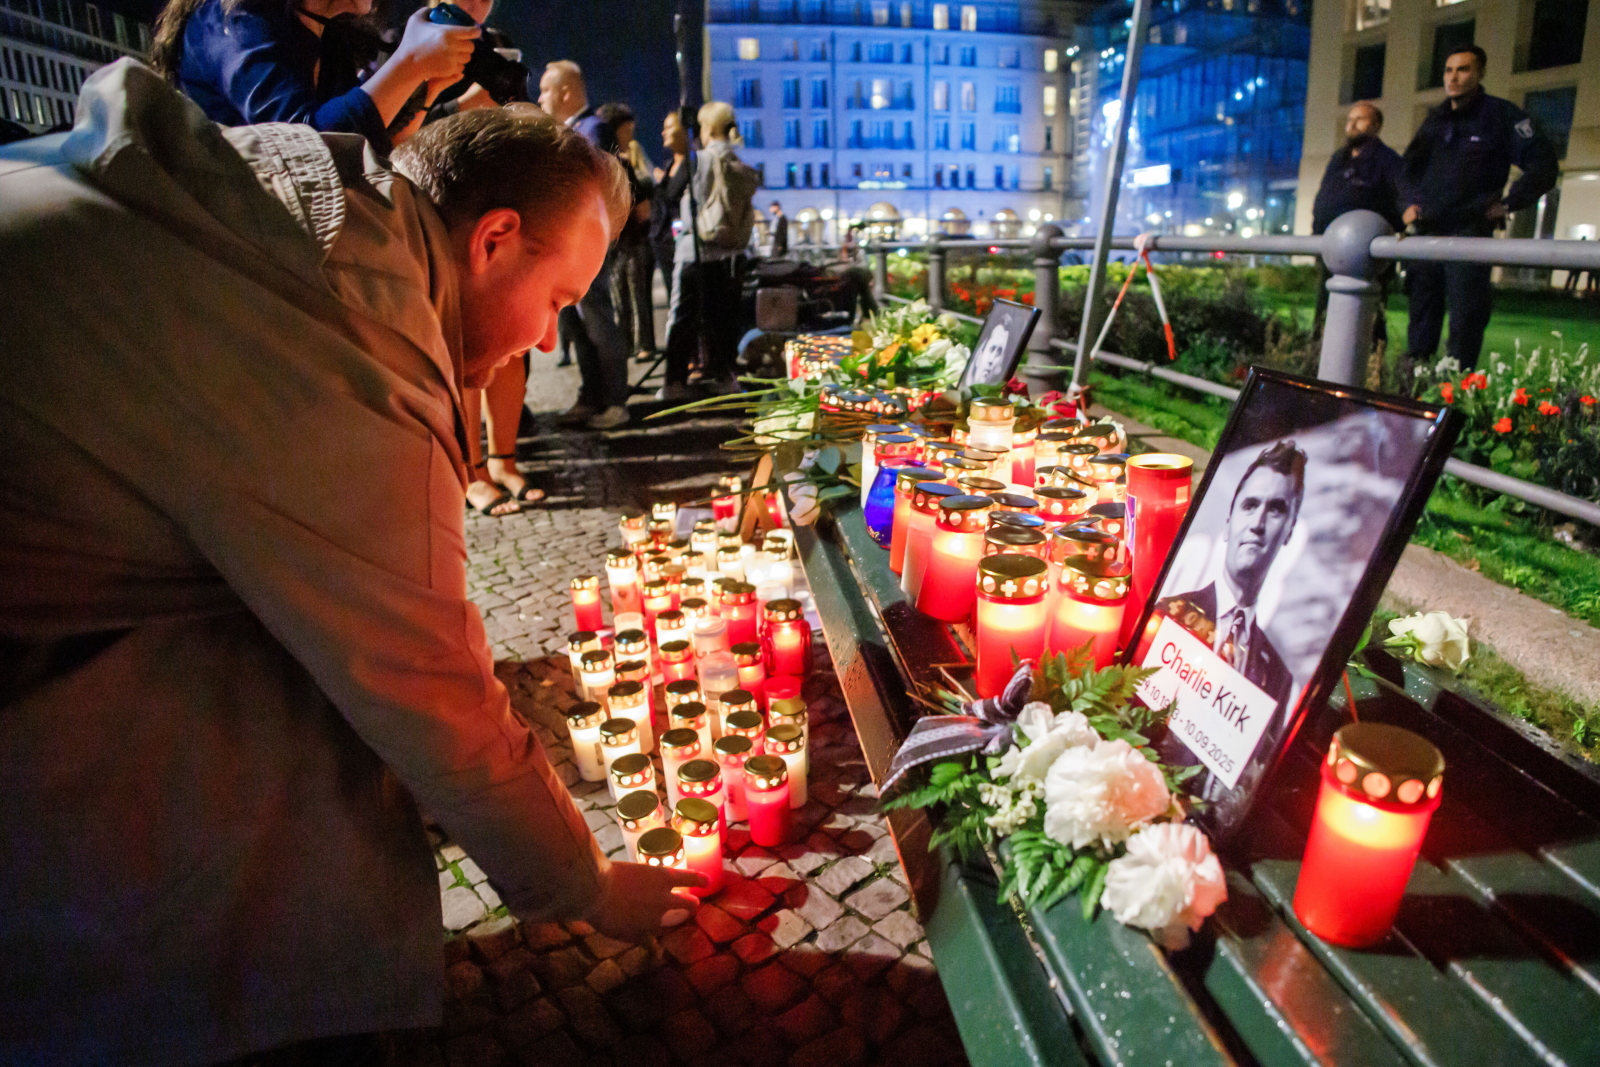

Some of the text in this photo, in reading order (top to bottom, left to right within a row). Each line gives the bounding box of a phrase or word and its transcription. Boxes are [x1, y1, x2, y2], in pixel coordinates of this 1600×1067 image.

[1141, 679, 1180, 720] 4.10.193
[1184, 719, 1235, 773] 10.09.2025
[1161, 642, 1252, 733] Charlie Kirk
